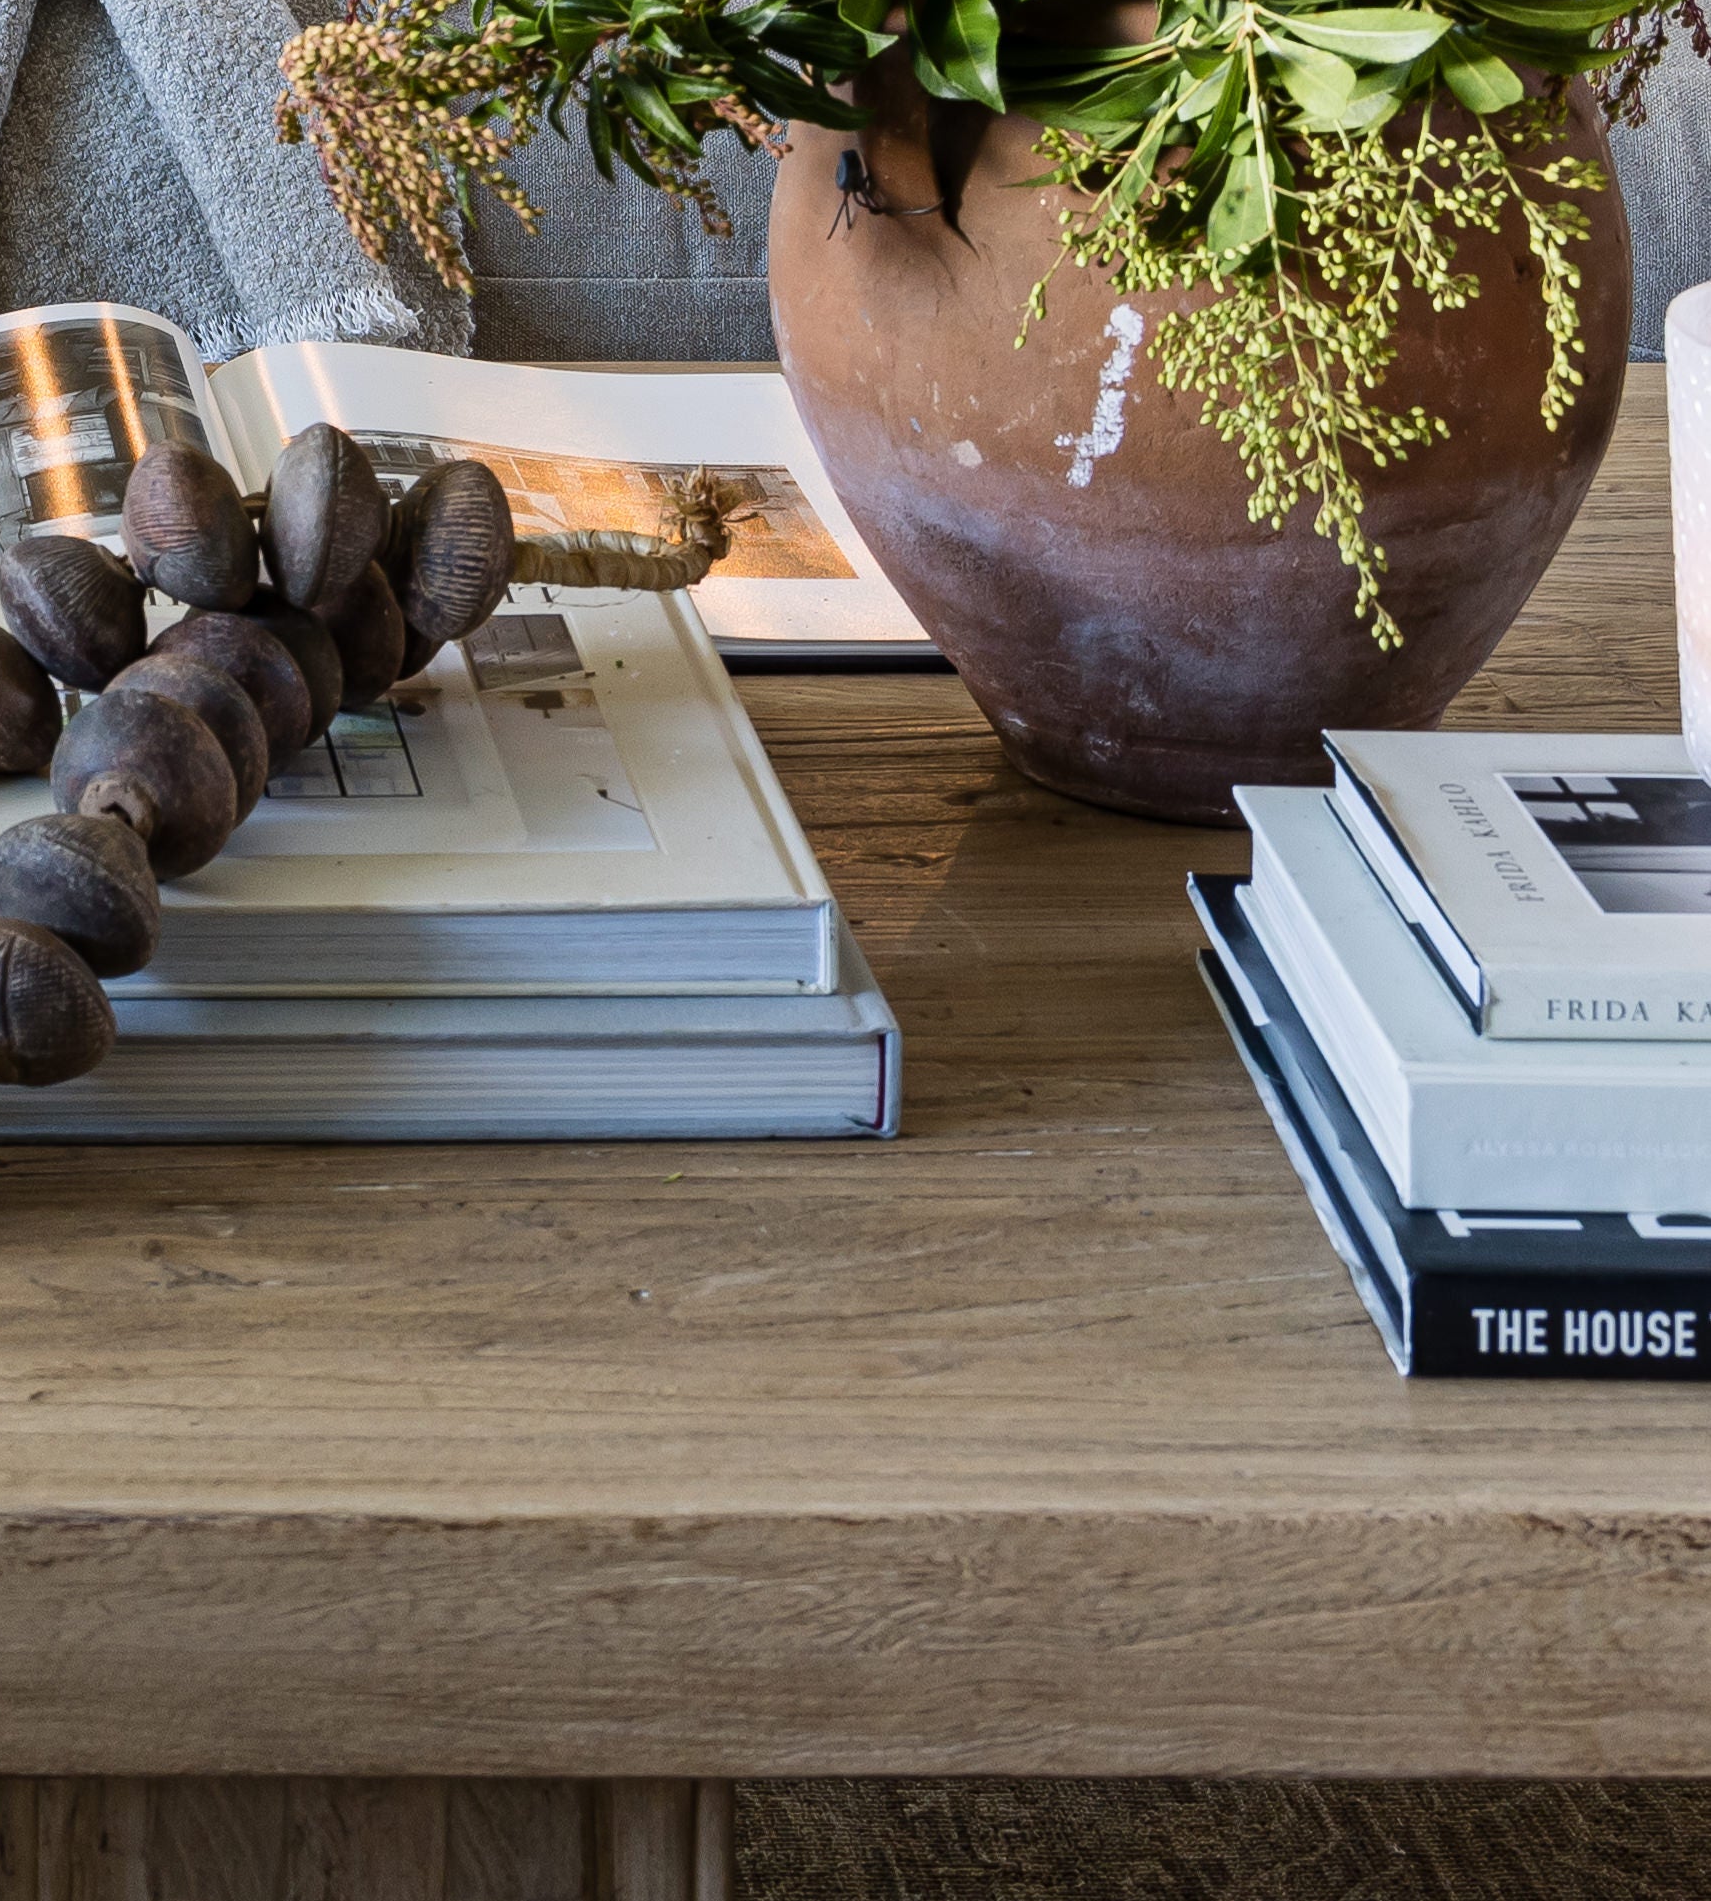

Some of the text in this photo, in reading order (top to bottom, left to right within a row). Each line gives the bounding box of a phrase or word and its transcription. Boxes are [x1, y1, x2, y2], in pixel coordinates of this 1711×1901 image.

[1438, 783, 1545, 902] FRIDA KAHLO
[1546, 999, 1650, 1022] FRIDA
[1471, 1308, 1698, 1358] THE HOUSE
